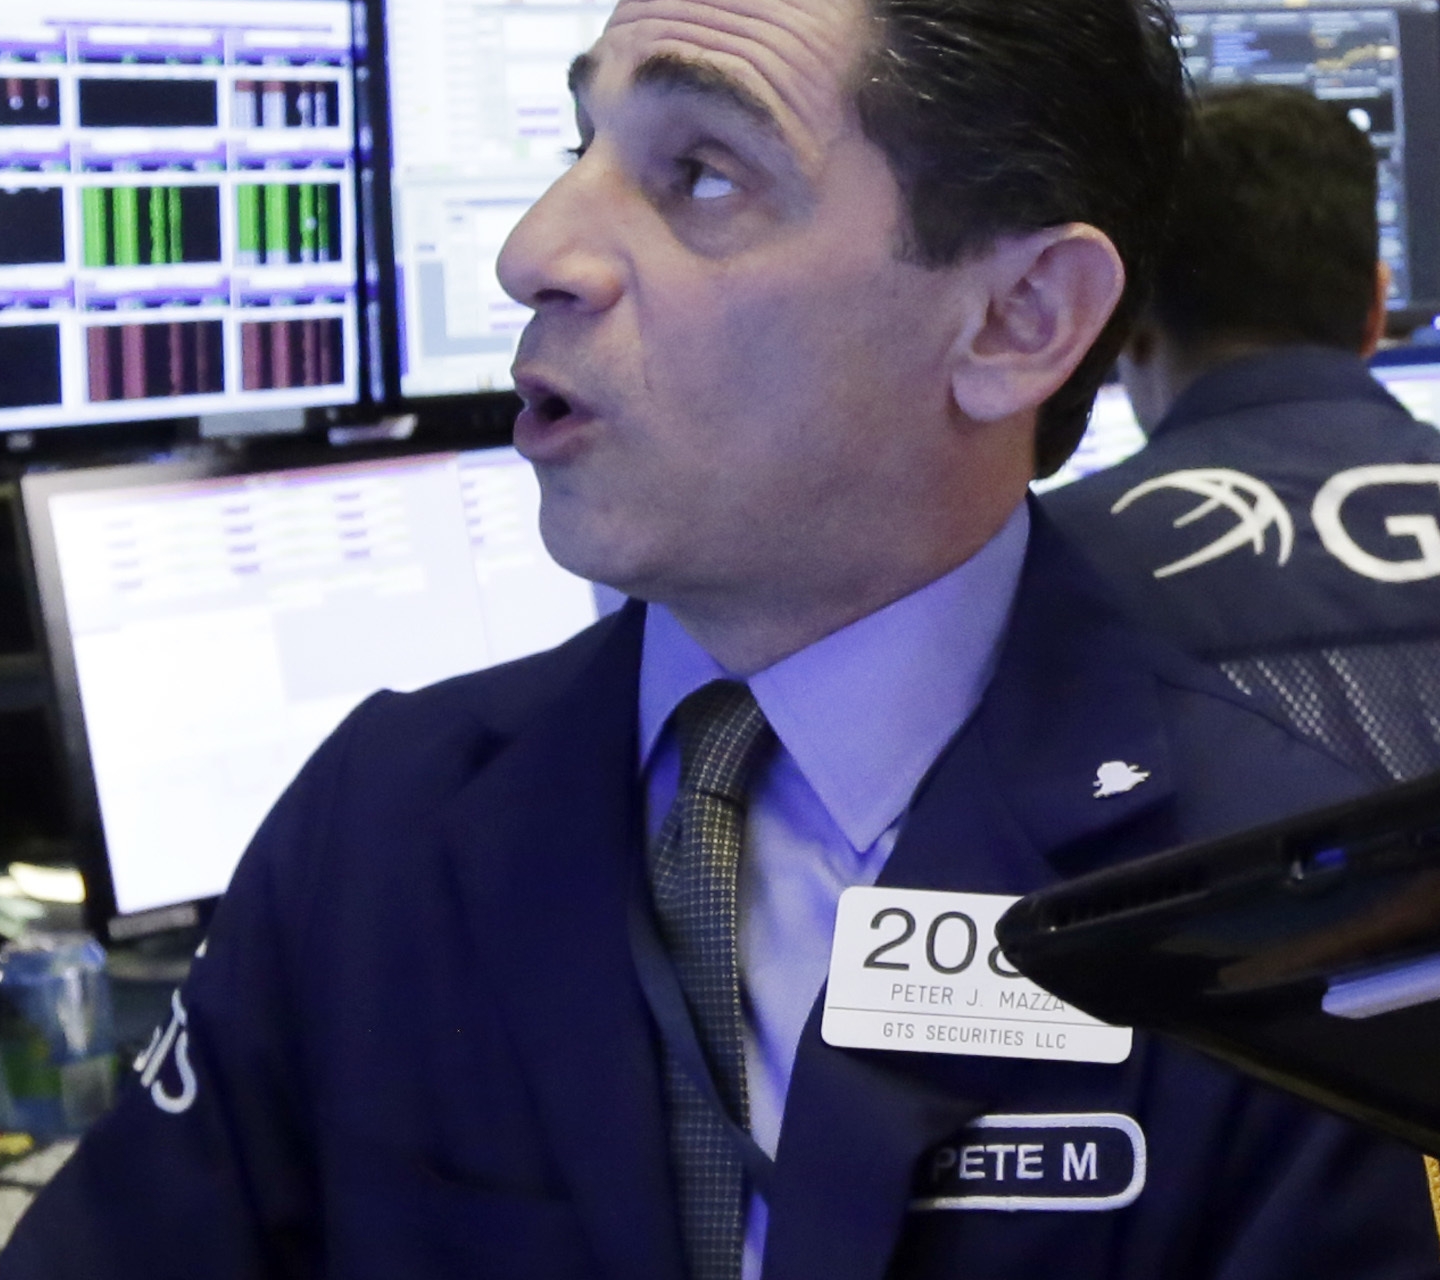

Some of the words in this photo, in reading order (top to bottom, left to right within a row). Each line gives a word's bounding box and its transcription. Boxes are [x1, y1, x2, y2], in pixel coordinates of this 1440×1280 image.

[863, 907, 1028, 978] 20
[891, 983, 954, 1005] PETER
[966, 988, 984, 1008] J.
[132, 987, 197, 1114] TS
[882, 1022, 915, 1040] GTS
[926, 1025, 1024, 1047] SECURITIES
[1035, 1032, 1067, 1049] LLC
[1062, 1142, 1098, 1182] M
